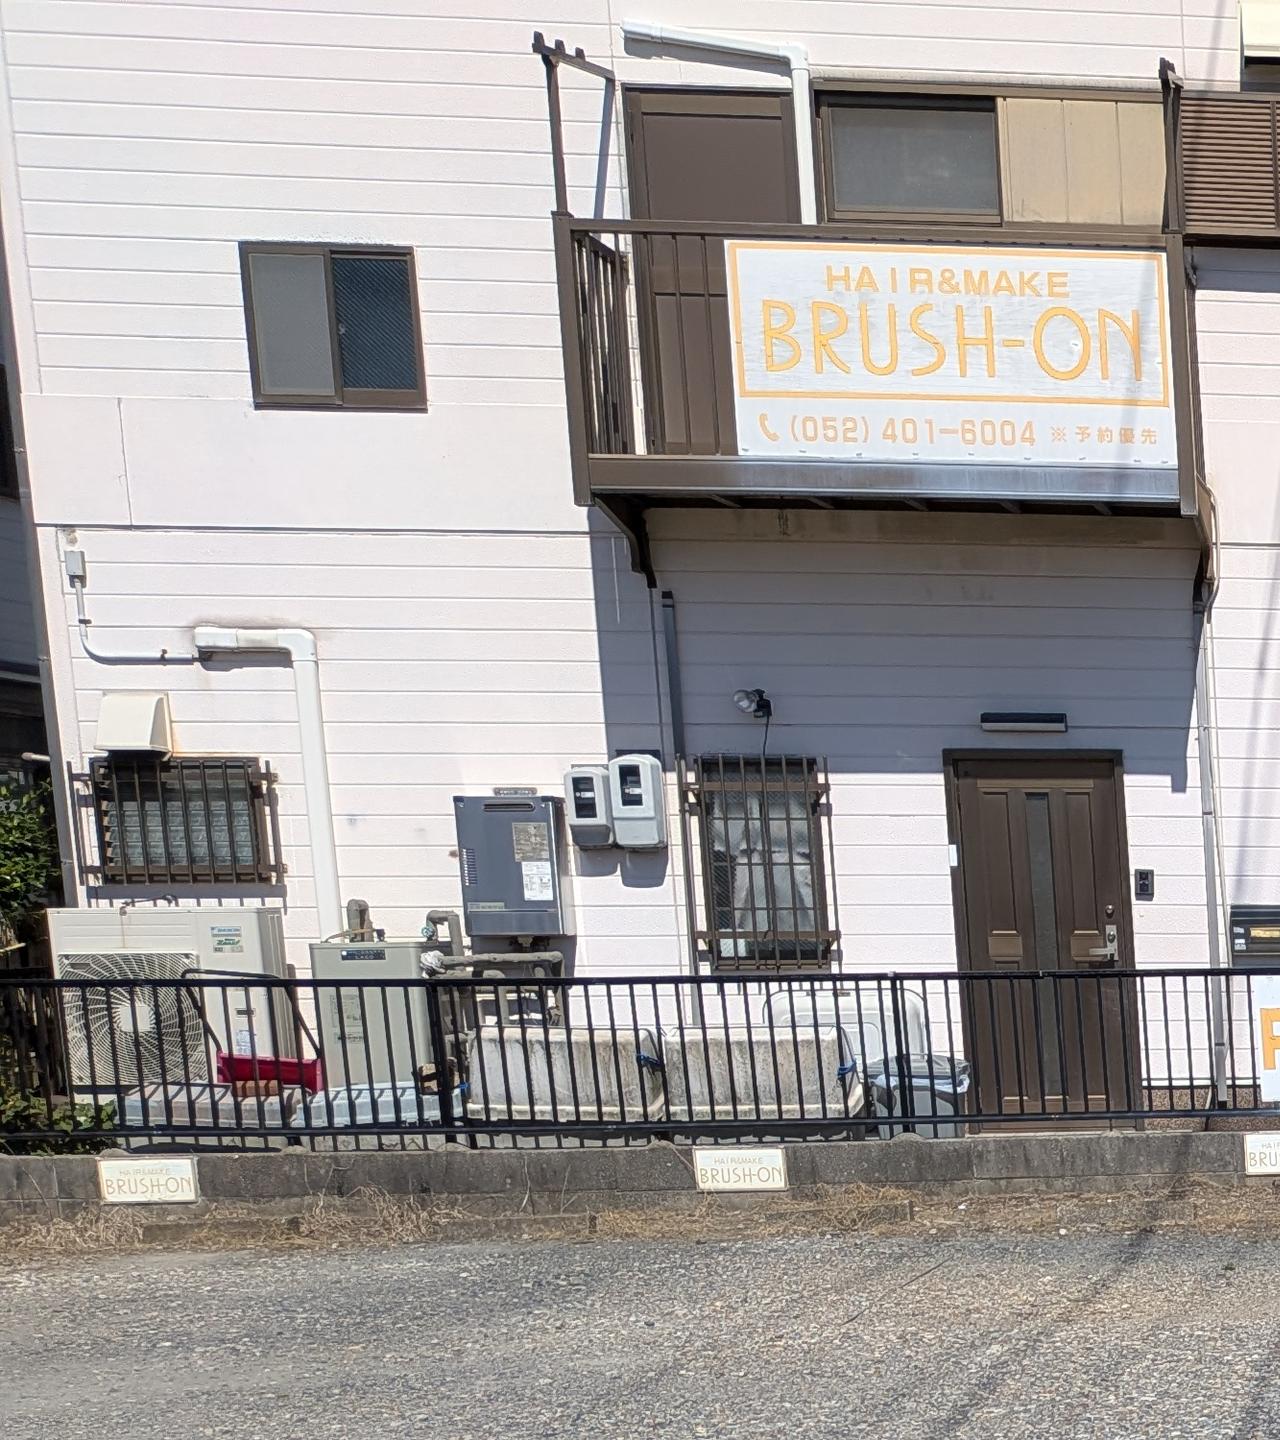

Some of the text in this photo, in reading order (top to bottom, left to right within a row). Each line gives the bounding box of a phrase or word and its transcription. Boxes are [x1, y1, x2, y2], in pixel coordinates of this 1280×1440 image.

[825, 265, 1070, 297] HAIR&MAKE
[761, 299, 1143, 381] BRUSH-ON
[790, 414, 869, 444] (052)
[881, 416, 1036, 446] 401-6004
[105, 1176, 193, 1195] BRUSH-ON
[699, 1166, 783, 1184] BRUSH-ON
